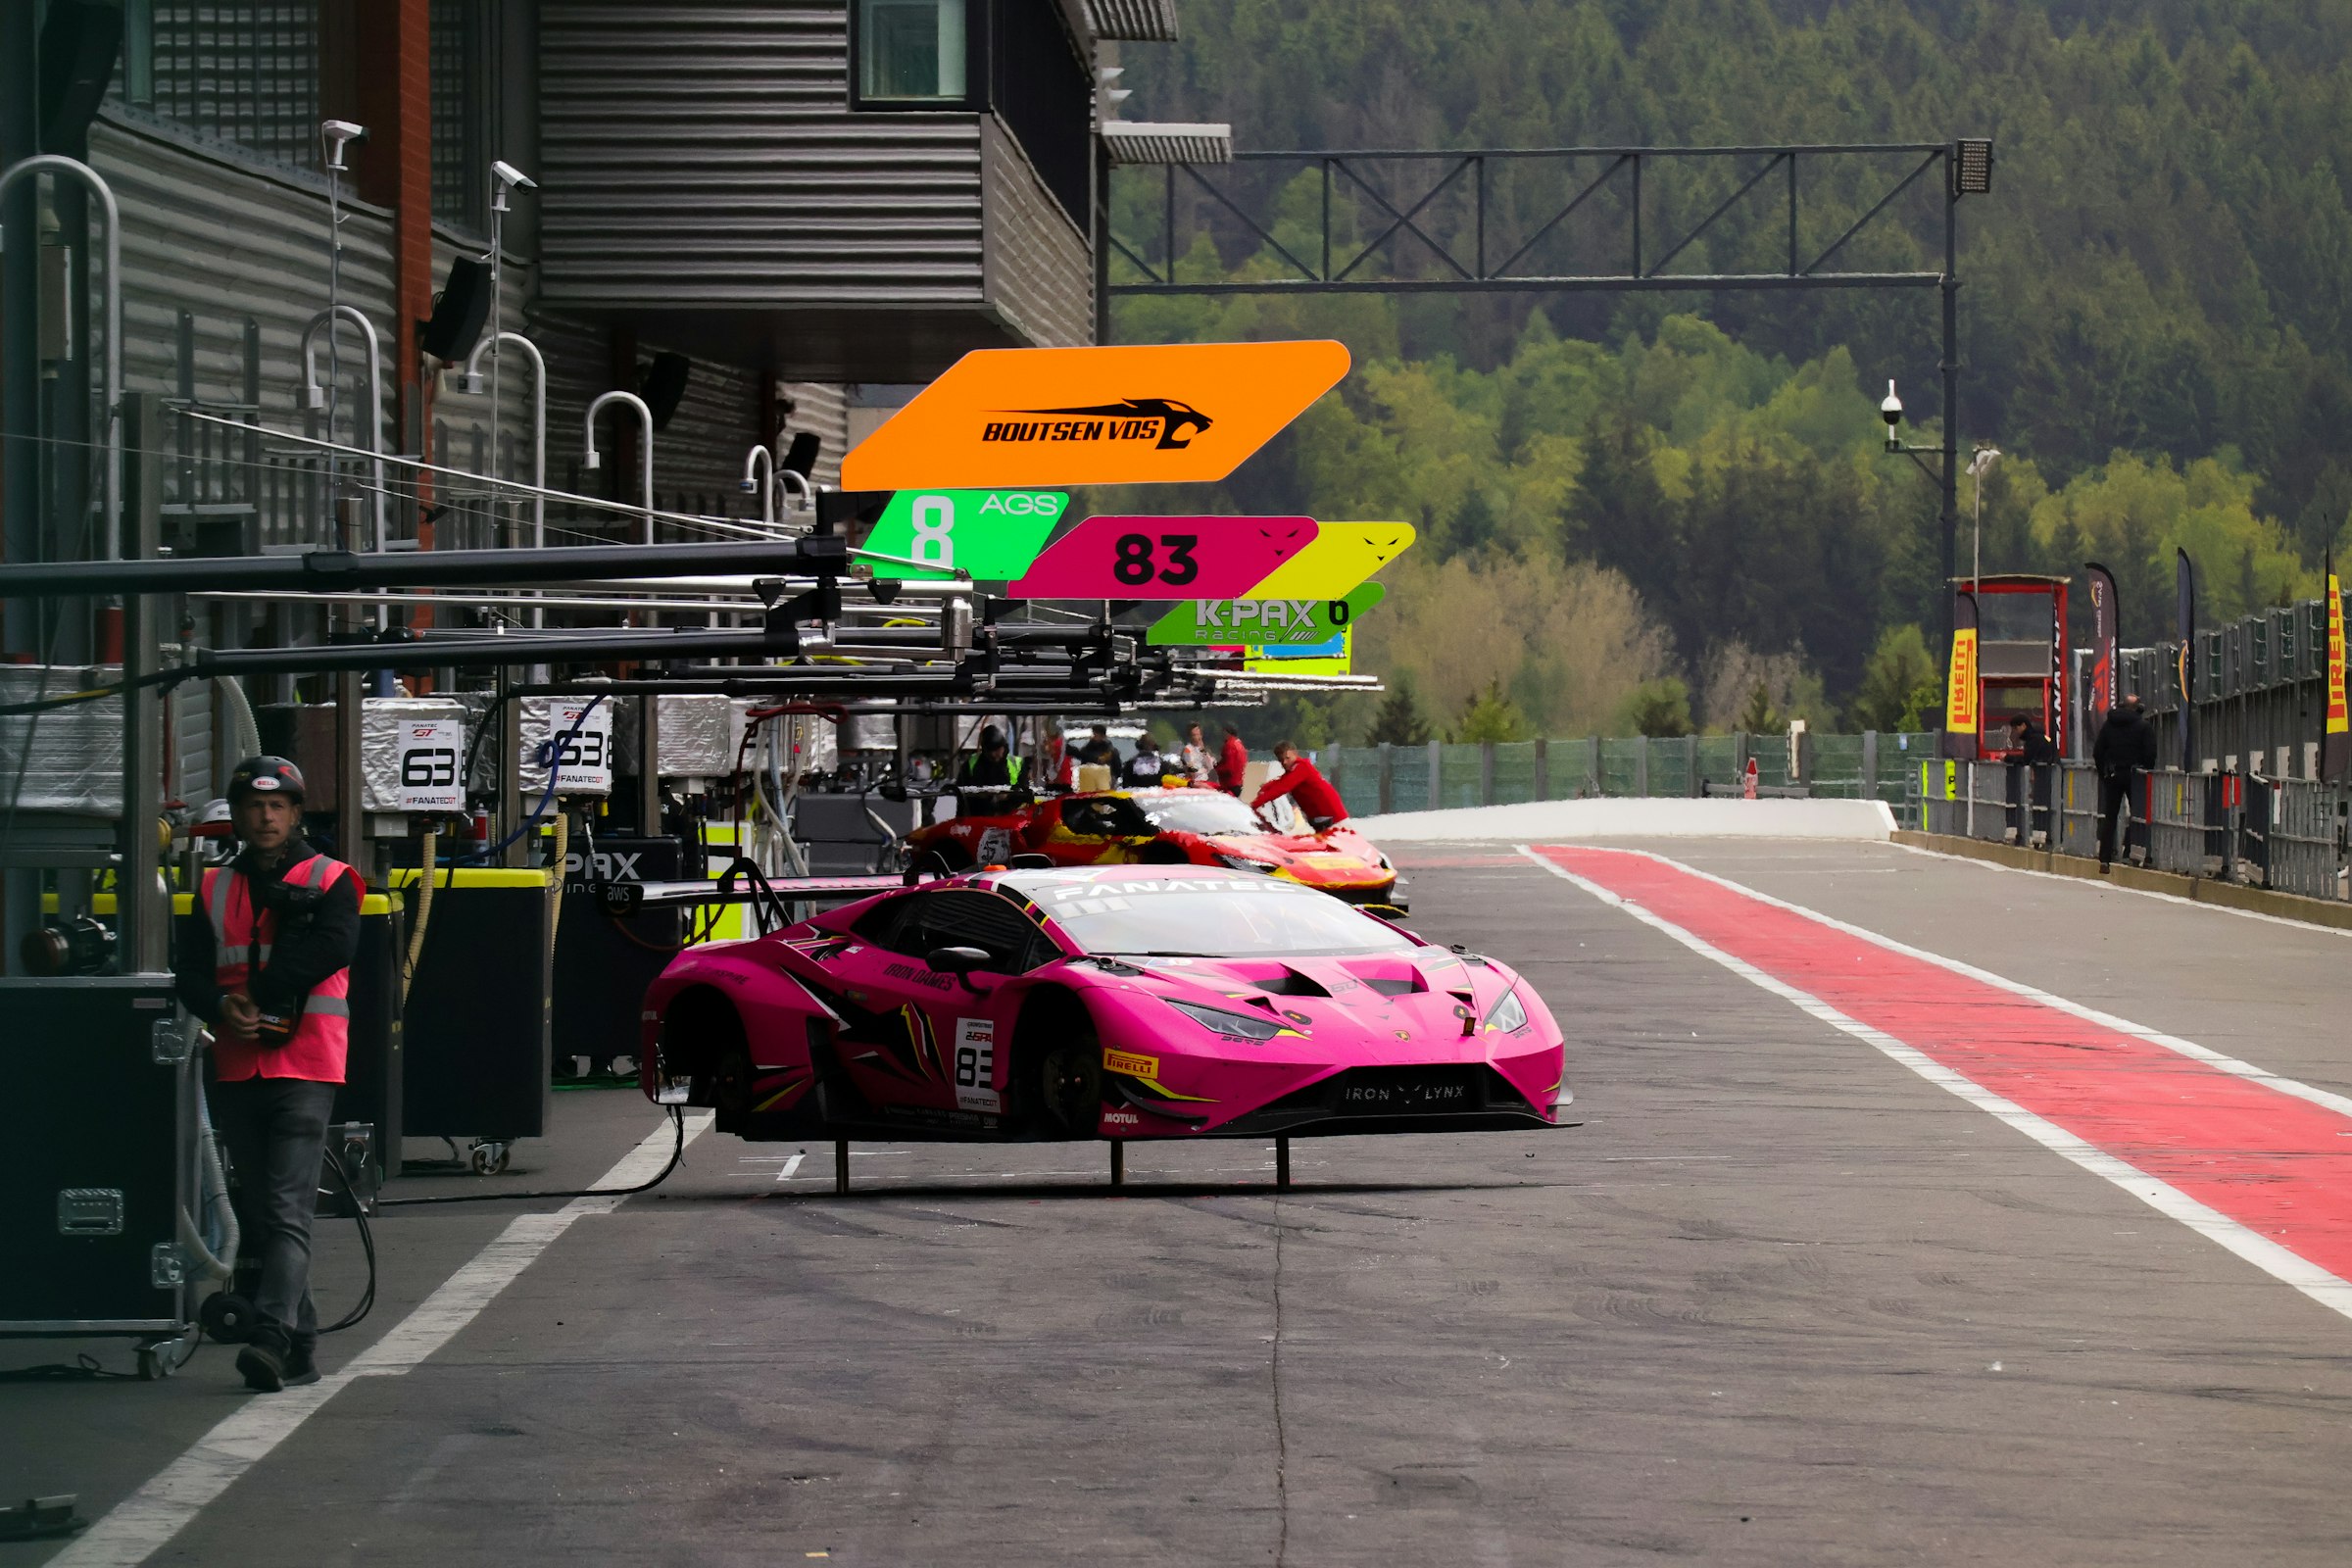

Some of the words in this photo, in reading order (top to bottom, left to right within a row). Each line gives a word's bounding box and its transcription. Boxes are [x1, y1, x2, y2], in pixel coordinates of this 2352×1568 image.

[982, 420, 1103, 442] BOUTSEN
[979, 493, 1057, 515] AGS
[911, 495, 955, 571] 8
[1112, 533, 1199, 586] 83
[1196, 600, 1318, 628] K-PAX
[554, 730, 604, 767] 63
[401, 748, 456, 787] 63
[406, 796, 457, 805] #FANATECGT
[540, 853, 643, 882] PAX
[607, 886, 630, 902] aws
[1054, 880, 1297, 901] FANATEC
[883, 963, 915, 980] IRON
[911, 969, 957, 992] DAMES
[1107, 1053, 1152, 1074] PIRELLI
[1346, 1087, 1390, 1101] IRON
[1425, 1085, 1464, 1100] LYNX
[1103, 1112, 1139, 1124] MOTUL
